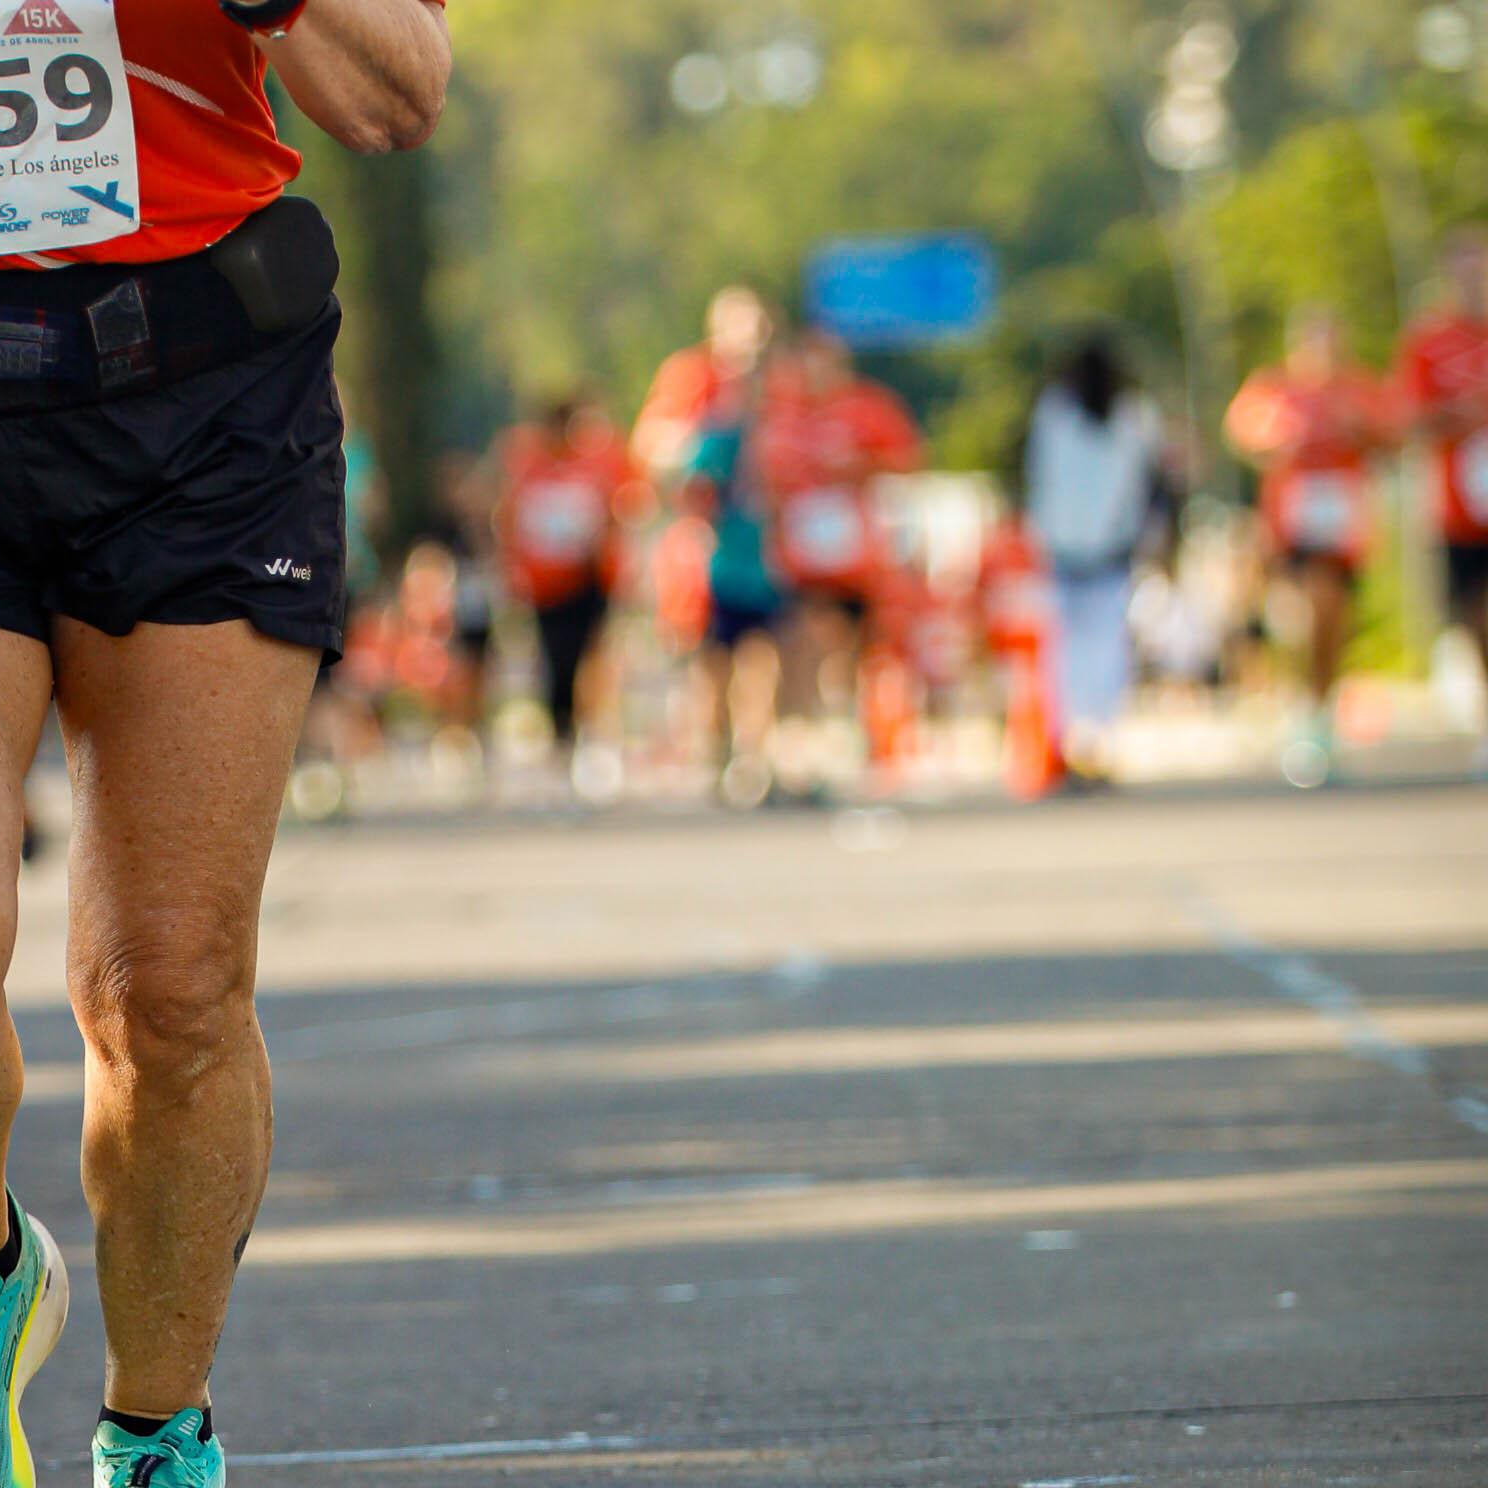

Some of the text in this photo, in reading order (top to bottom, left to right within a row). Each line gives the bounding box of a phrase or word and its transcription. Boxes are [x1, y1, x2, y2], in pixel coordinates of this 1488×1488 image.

[20, 8, 62, 28] 15K
[11, 158, 44, 175] Los
[50, 151, 120, 174] ángeles
